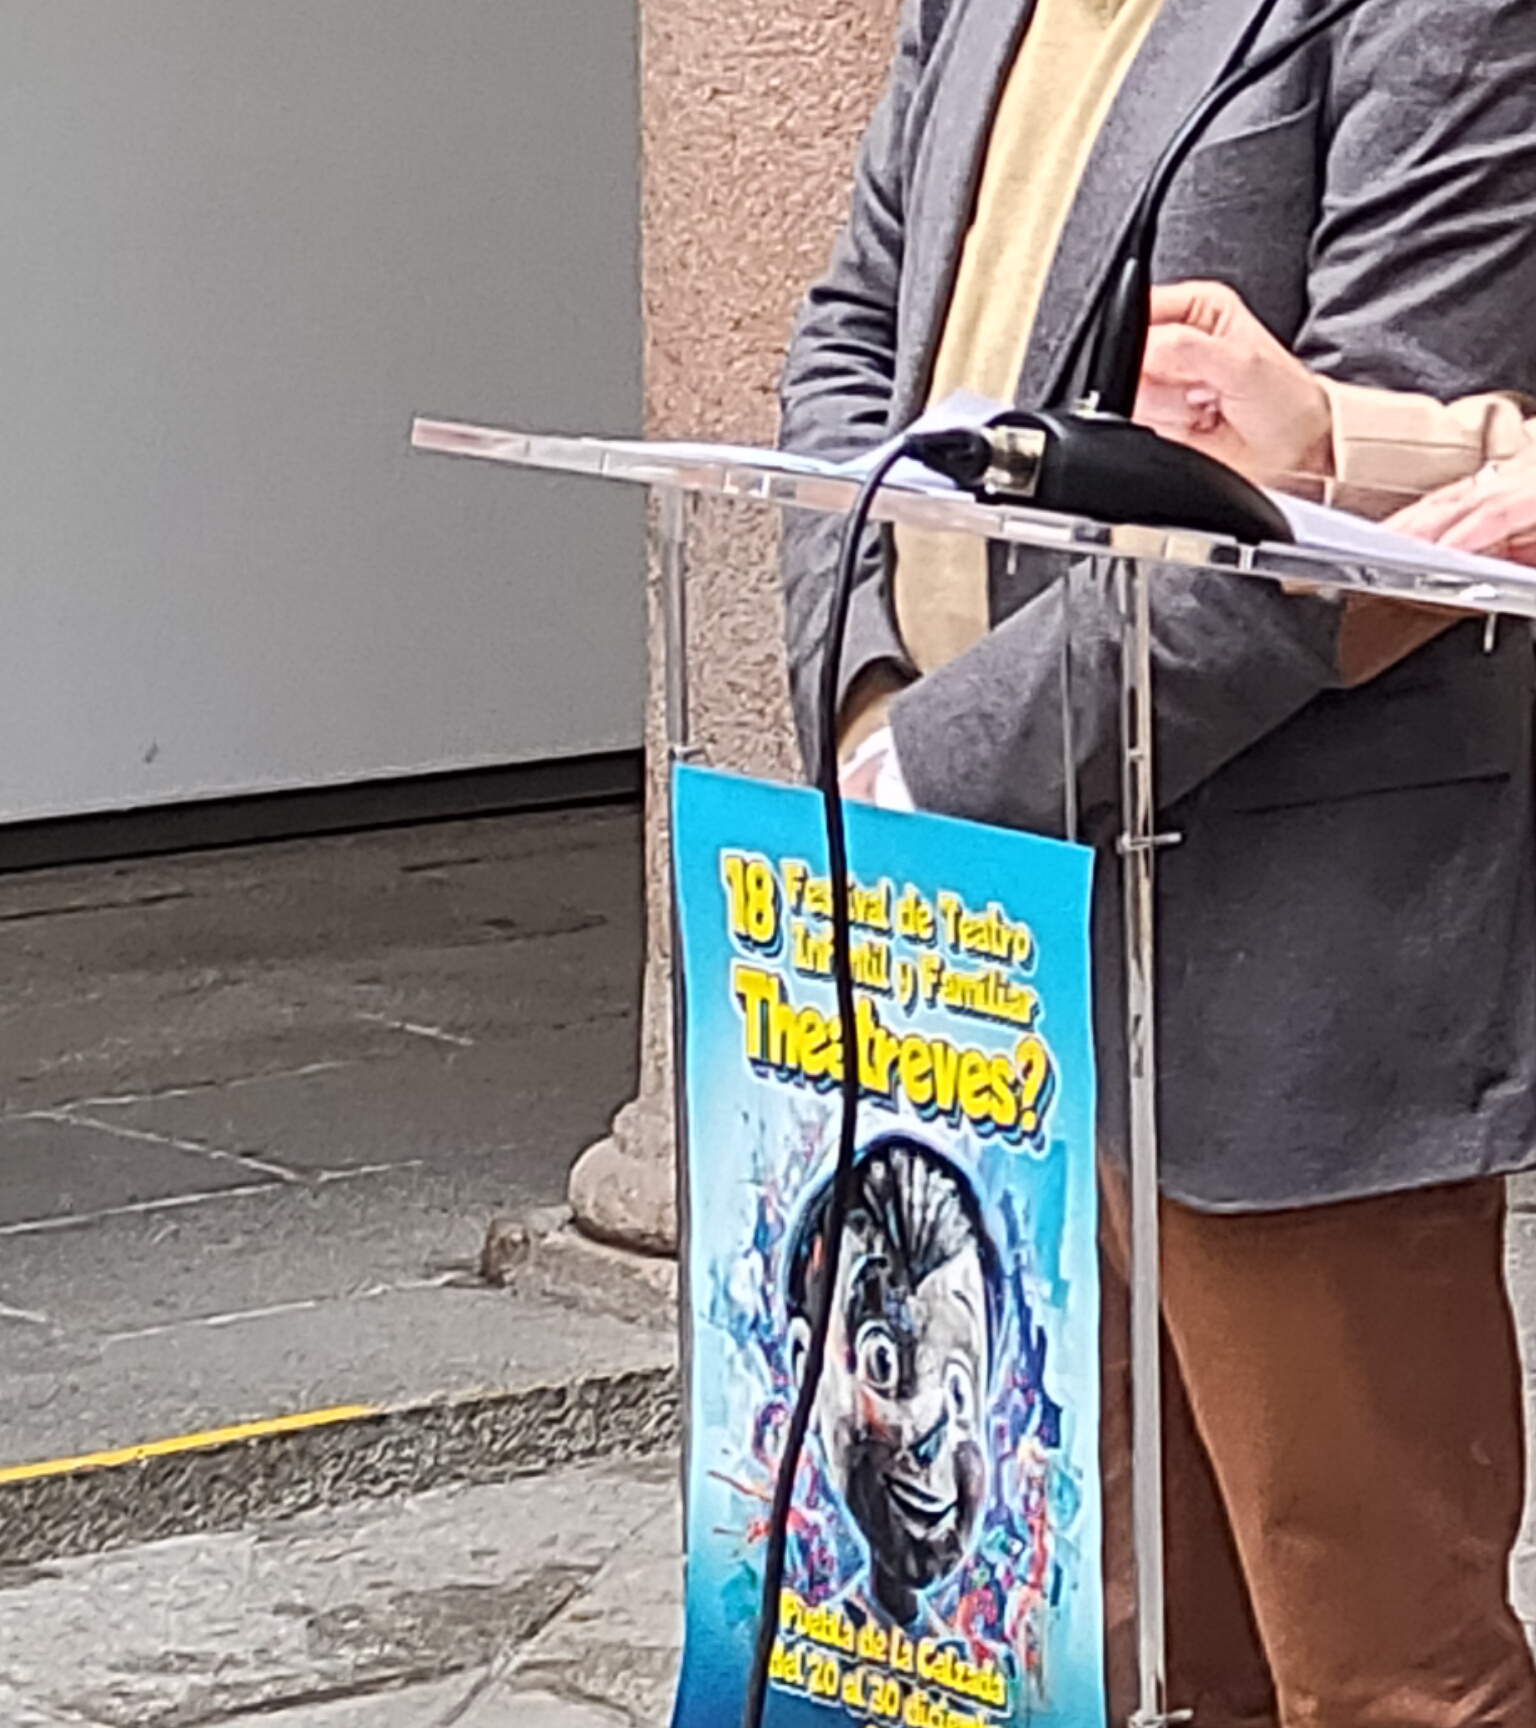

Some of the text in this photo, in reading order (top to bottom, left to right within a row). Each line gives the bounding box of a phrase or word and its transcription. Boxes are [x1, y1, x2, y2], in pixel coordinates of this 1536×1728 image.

[725, 855, 1031, 963] 18 Fesival de Teatro
[791, 922, 891, 990] Infntil
[920, 956, 1037, 1023] Familiar
[780, 1590, 1005, 1706] Puebla de la Calzada
[806, 1653, 840, 1696] 20
[842, 1668, 867, 1708] al
